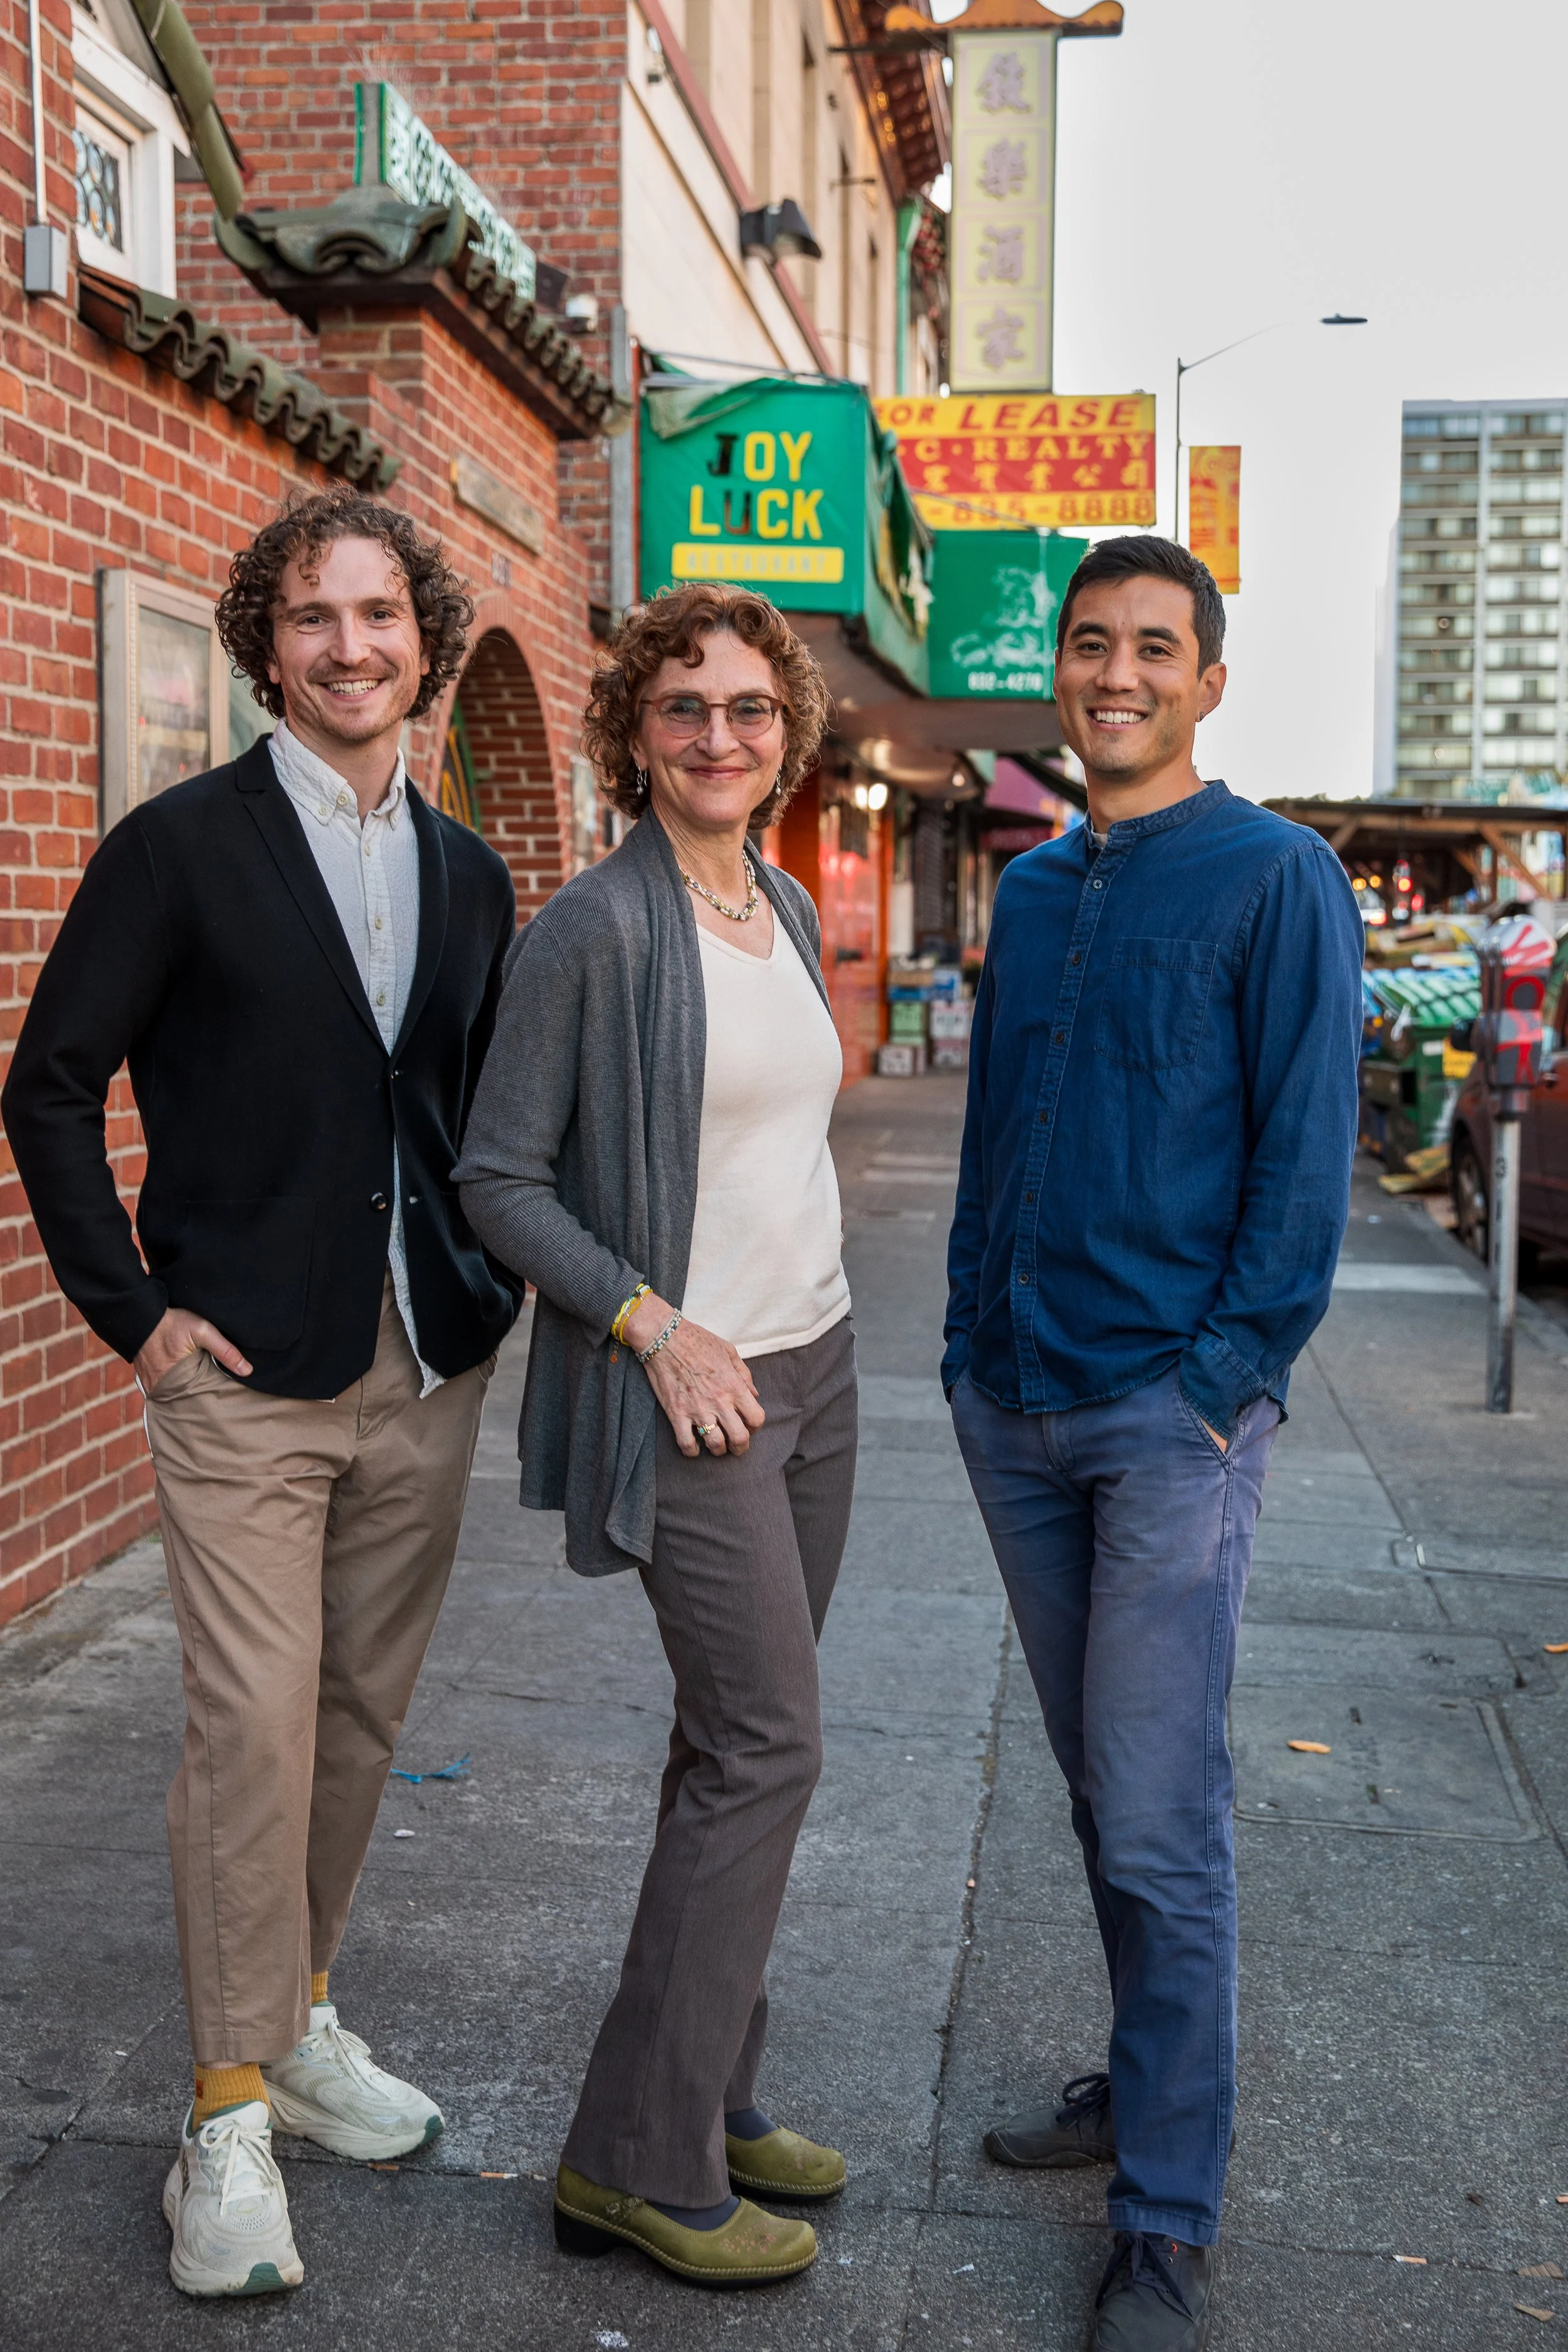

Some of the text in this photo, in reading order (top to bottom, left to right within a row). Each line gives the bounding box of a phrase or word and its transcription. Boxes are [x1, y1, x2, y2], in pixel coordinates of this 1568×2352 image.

[958, 400, 1142, 430] LEASE
[706, 431, 813, 482] JOY
[972, 435, 1147, 460] REALTY
[689, 484, 824, 541] LUCK
[686, 551, 825, 575] RESTAURANT
